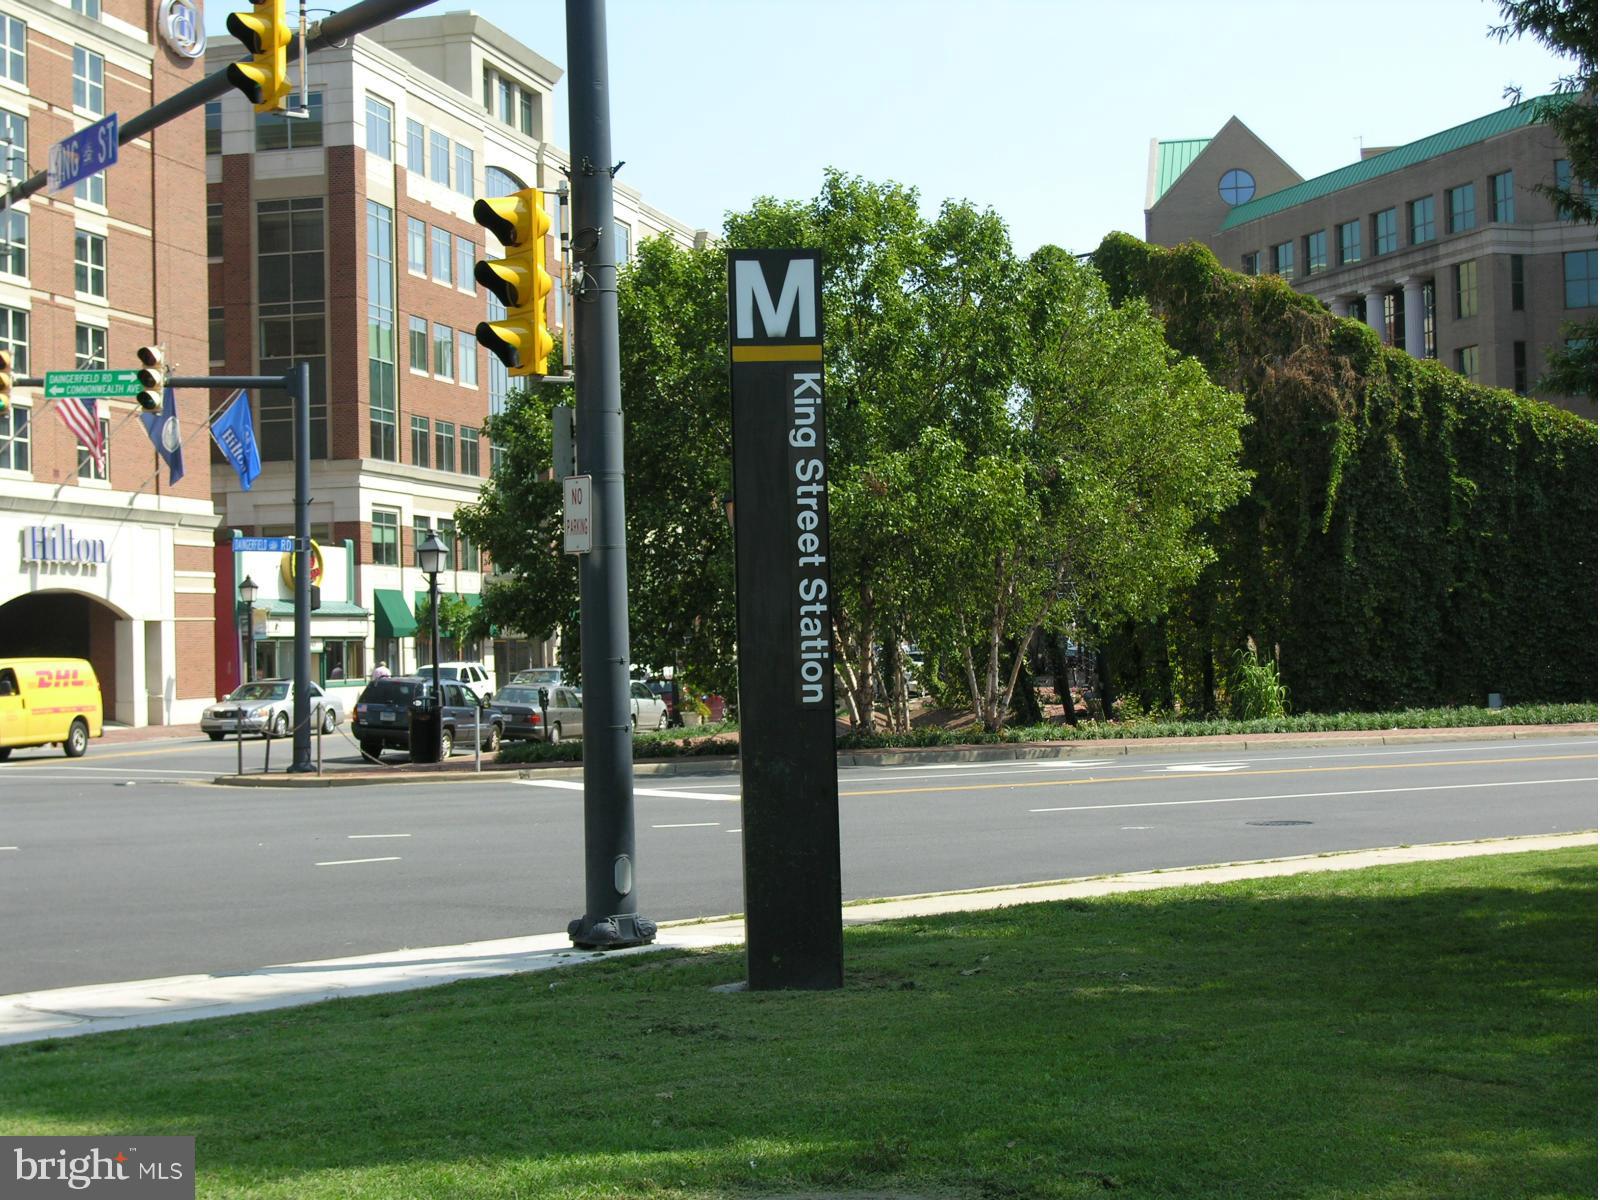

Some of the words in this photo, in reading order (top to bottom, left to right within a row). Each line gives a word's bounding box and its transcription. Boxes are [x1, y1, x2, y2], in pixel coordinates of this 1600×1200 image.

[98, 121, 114, 163] ST
[735, 258, 817, 339] M
[49, 374, 100, 384] DAINGERFIELD
[102, 373, 113, 383] RD
[66, 384, 124, 394] COMMONWEALTH
[126, 384, 141, 394] AVE
[788, 372, 822, 447] King
[571, 487, 583, 504] NO
[566, 517, 588, 535] PARKING
[795, 458, 826, 567] Street
[24, 523, 106, 563] Hilton
[281, 539, 293, 551] RD
[798, 578, 829, 703] Station
[35, 670, 84, 688] DHL
